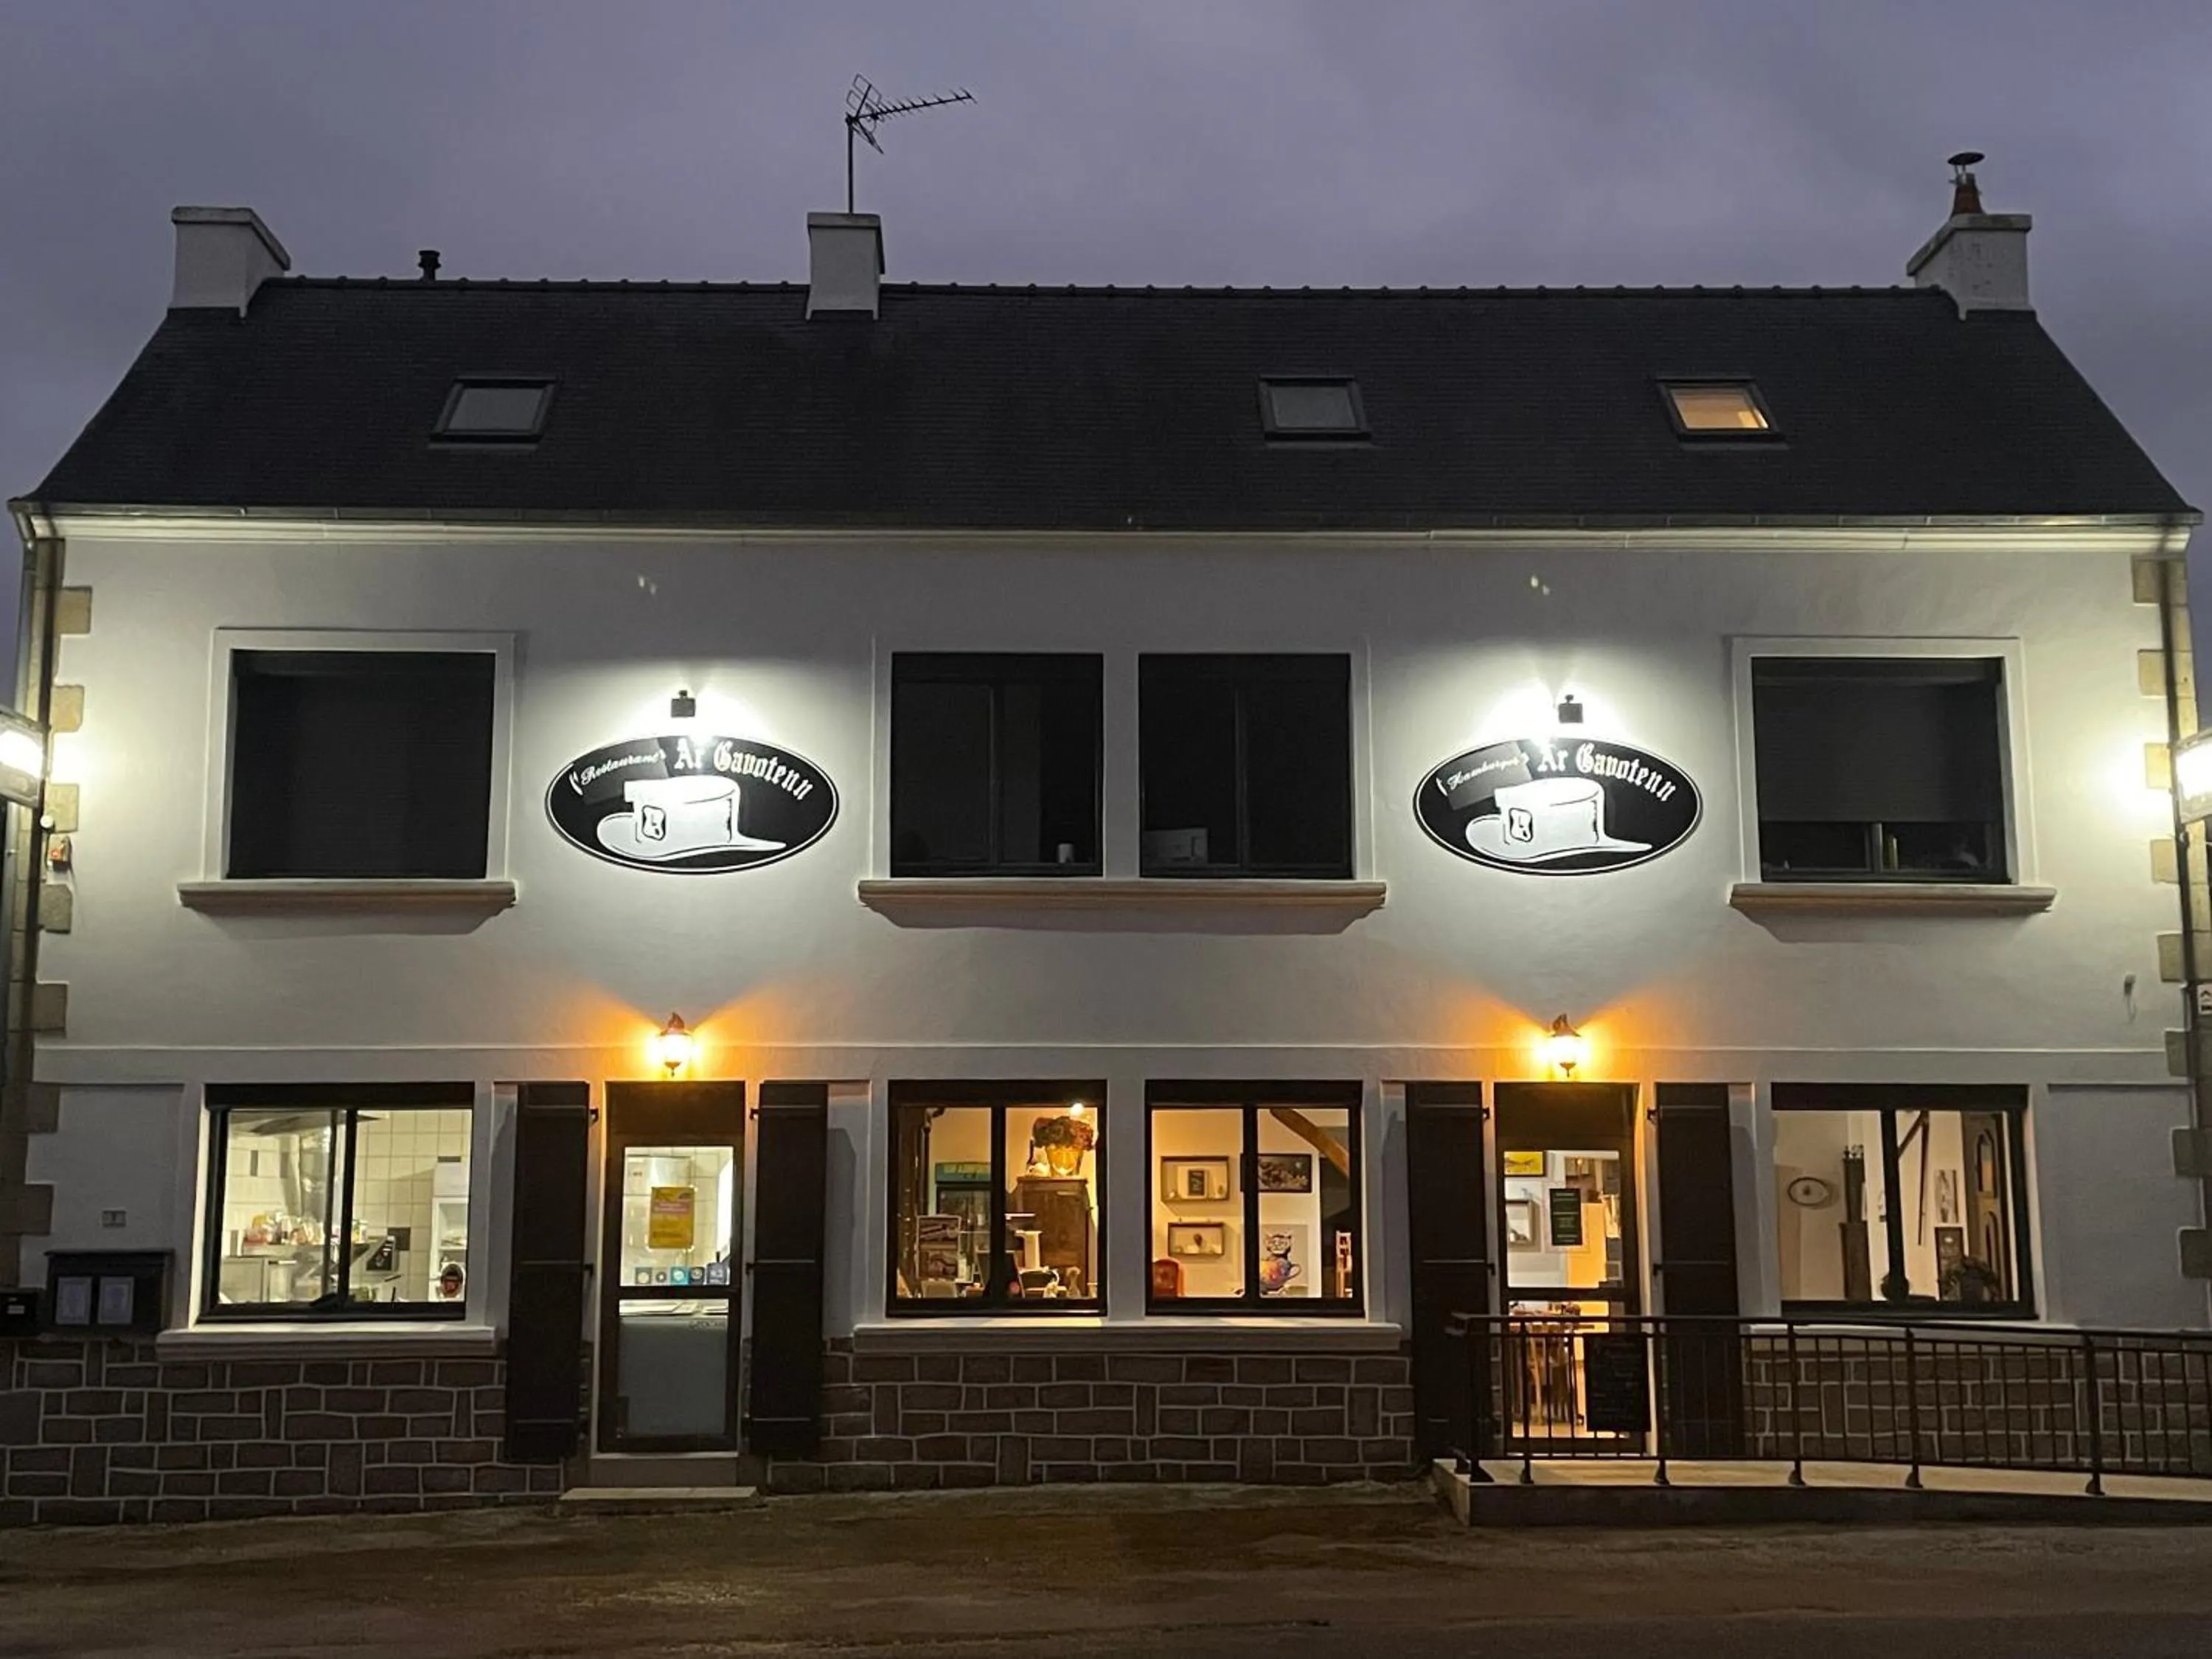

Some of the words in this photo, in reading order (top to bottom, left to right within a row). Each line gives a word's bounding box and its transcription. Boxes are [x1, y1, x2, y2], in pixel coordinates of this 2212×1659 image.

[674, 737, 706, 769] Ar
[714, 740, 813, 800] Gavotenn
[1537, 743, 1568, 772] Ar
[1576, 742, 1676, 801] Gavotenn
